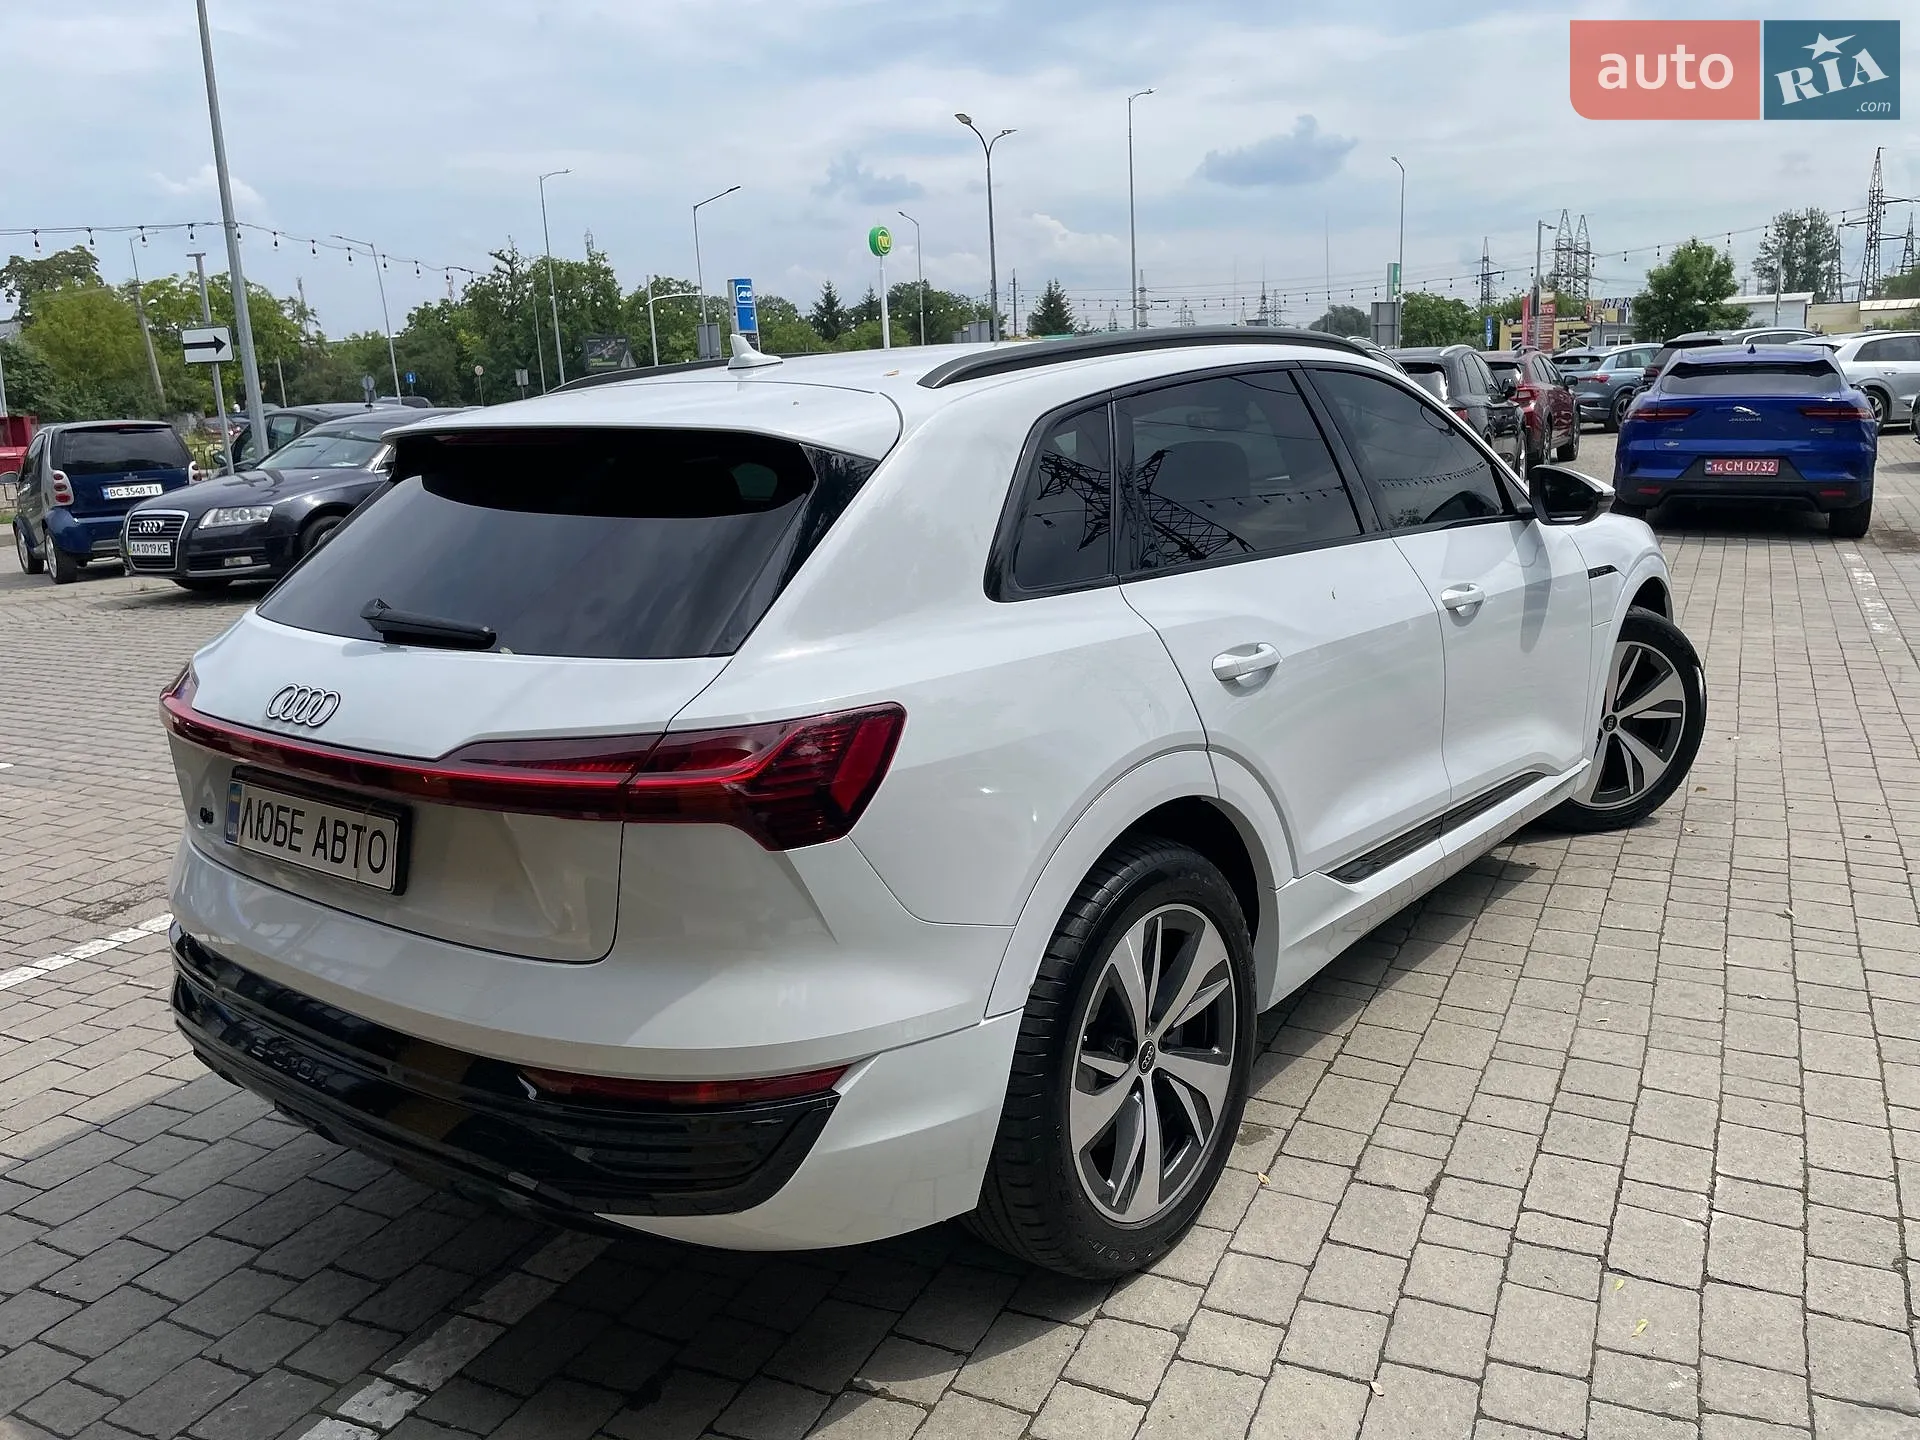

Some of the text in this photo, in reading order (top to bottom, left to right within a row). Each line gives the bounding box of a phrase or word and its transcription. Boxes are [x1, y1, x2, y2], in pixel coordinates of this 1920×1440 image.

[1713, 461, 1775, 472] 14 CM 0732
[109, 488, 123, 497] BC
[240, 797, 387, 874] ЛЮБЕ АВТО
